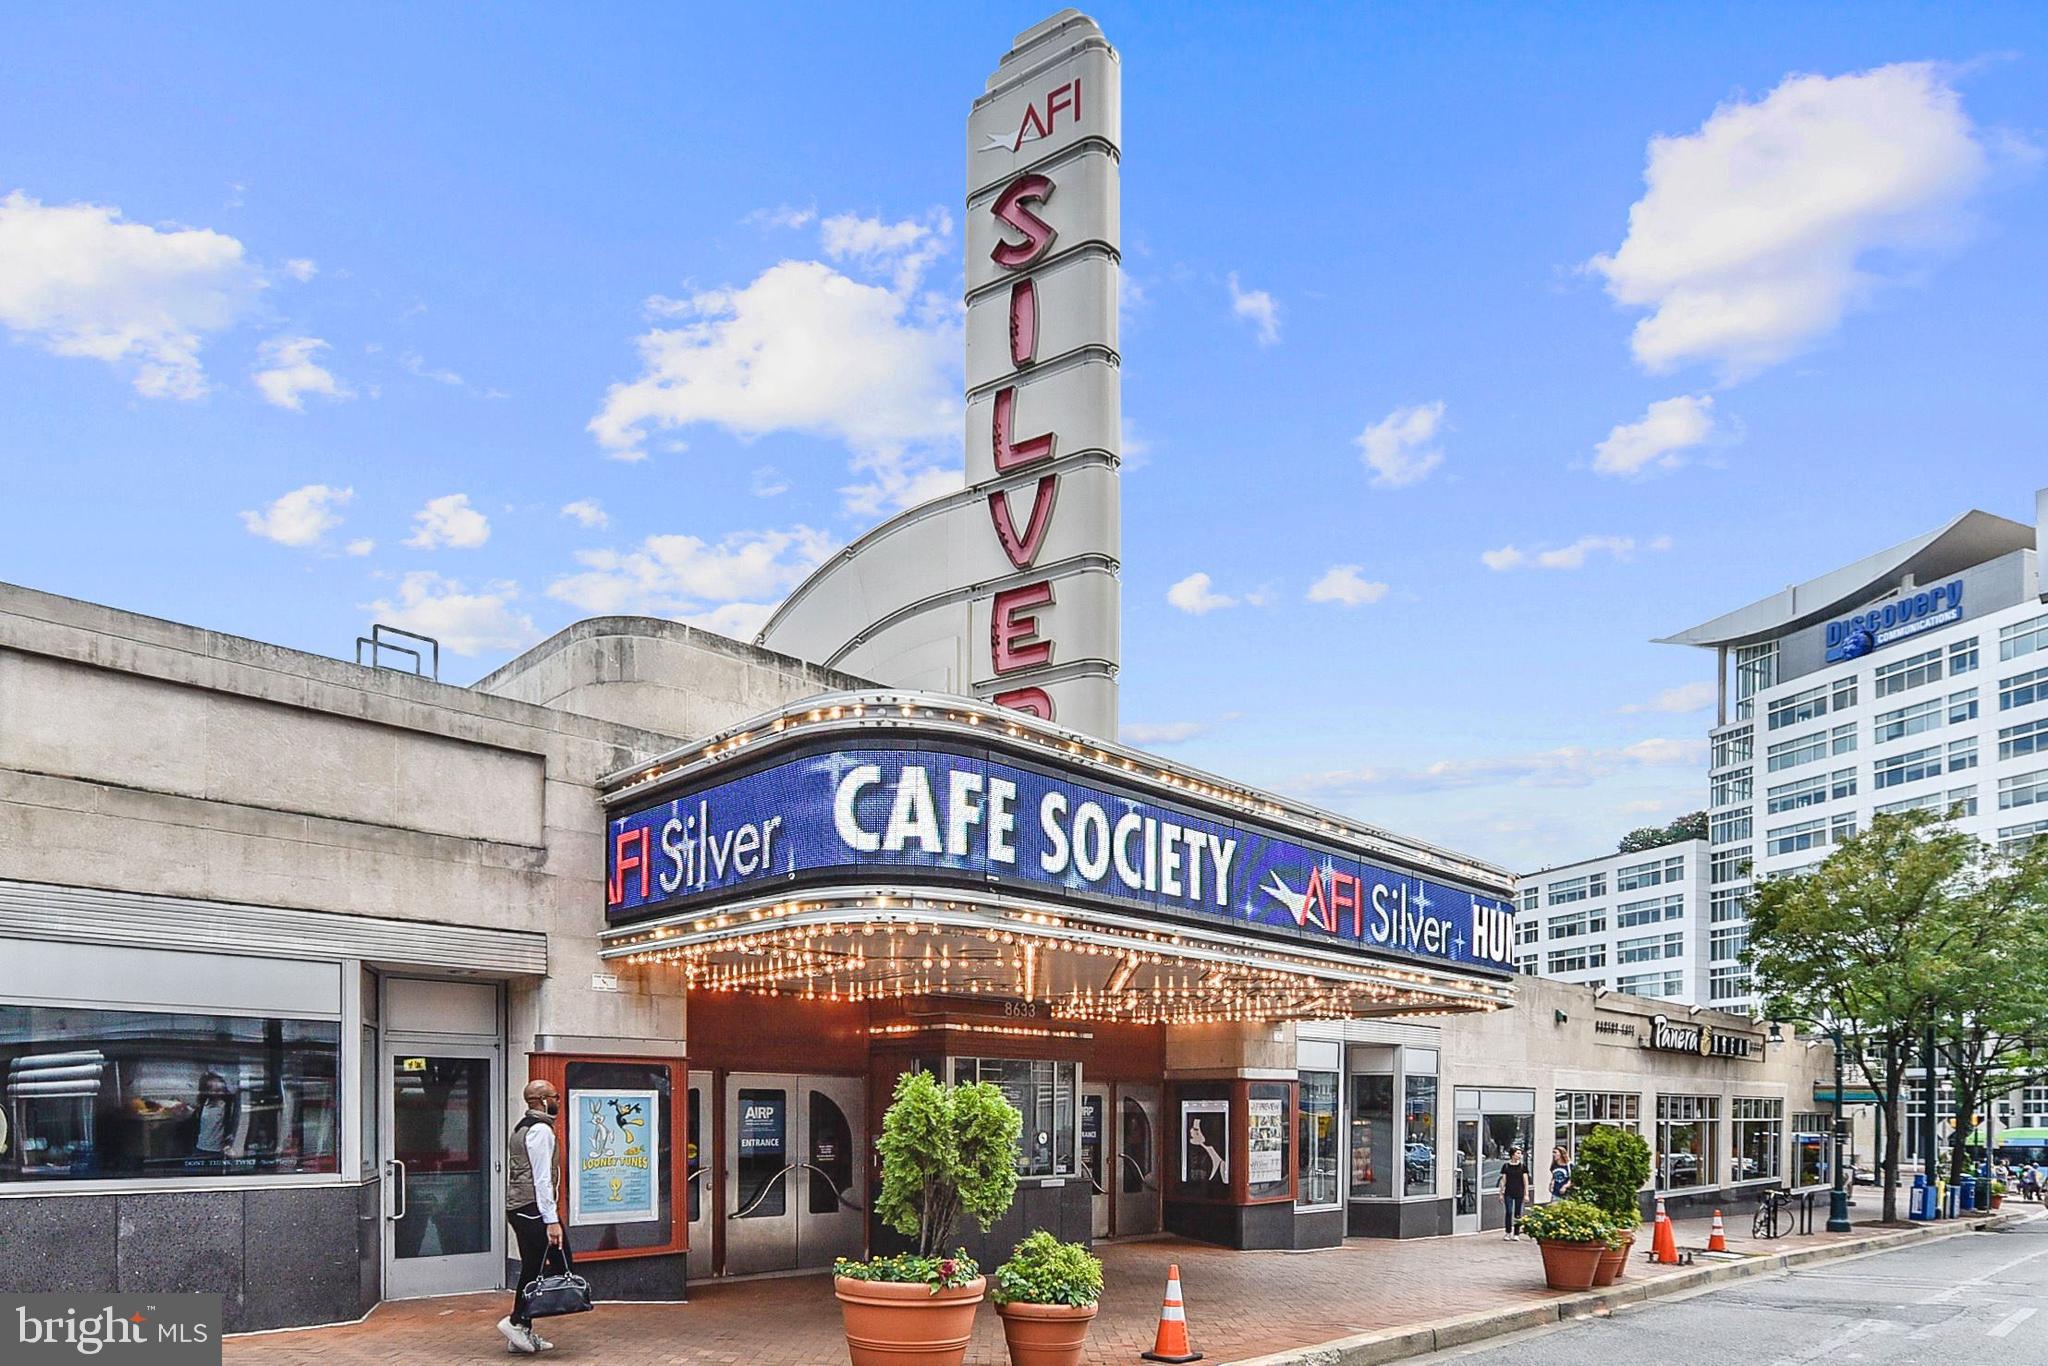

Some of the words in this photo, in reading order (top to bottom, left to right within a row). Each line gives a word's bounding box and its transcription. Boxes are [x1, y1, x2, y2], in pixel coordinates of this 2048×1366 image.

[1014, 78, 1081, 152] AFI
[1826, 579, 1963, 648] Discovery
[1877, 608, 1958, 643] COMMUNICATIONS
[608, 826, 650, 904] FI
[659, 800, 782, 893] Silver
[833, 765, 1017, 865] CAFE
[1040, 791, 1237, 906] SOCIETY
[1300, 865, 1363, 938] AFI
[1371, 882, 1453, 953] Silver
[1004, 1001, 1036, 1018] 8633
[1654, 1015, 1698, 1051] Panera
[745, 1106, 774, 1119] AIRP
[741, 1139, 779, 1147] ENTRANCE
[582, 1157, 617, 1171] LOONEY
[620, 1157, 648, 1169] TUNES
